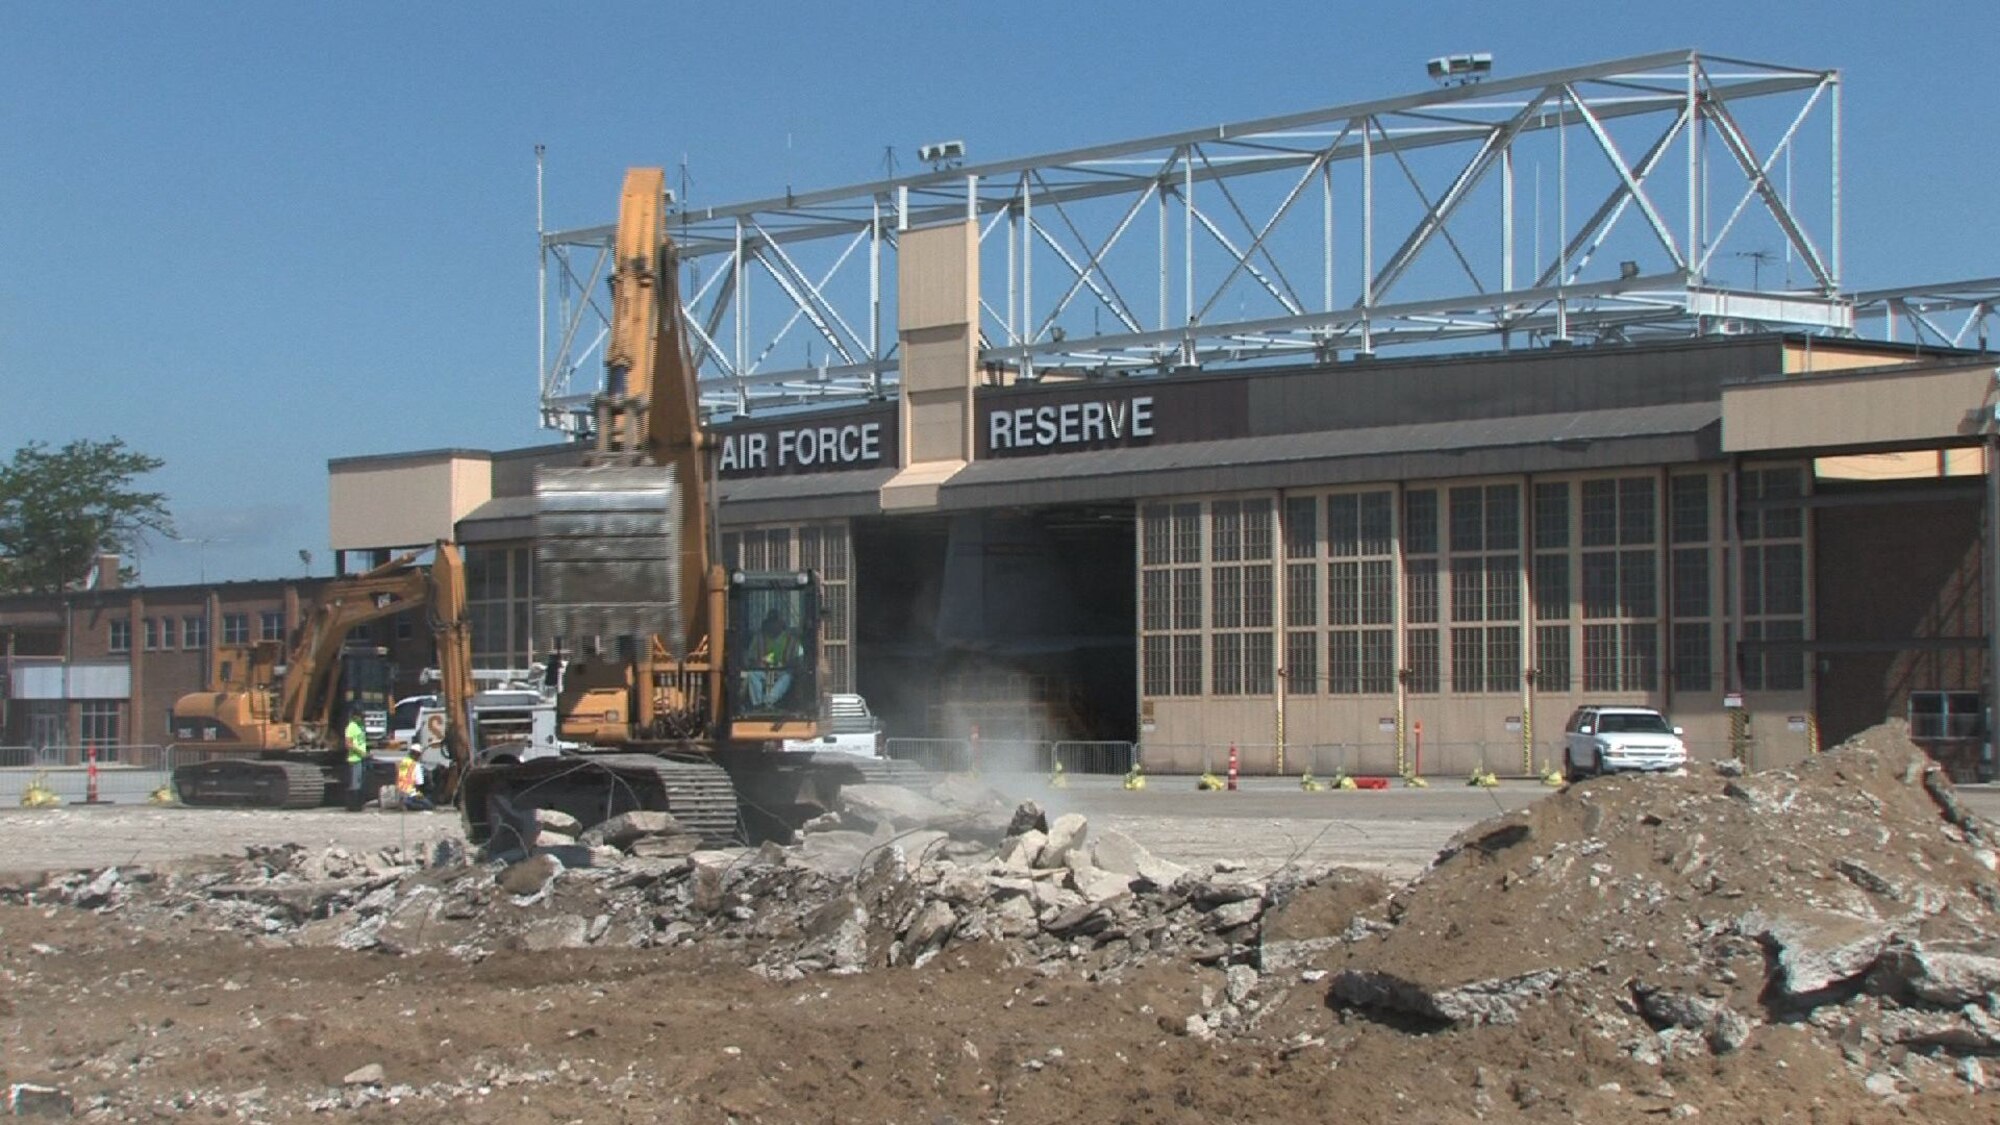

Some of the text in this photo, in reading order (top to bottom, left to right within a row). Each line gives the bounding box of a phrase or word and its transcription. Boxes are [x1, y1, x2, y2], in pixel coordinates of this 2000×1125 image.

[719, 423, 880, 471] AIR FORCE
[990, 397, 1154, 449] RESERVE
